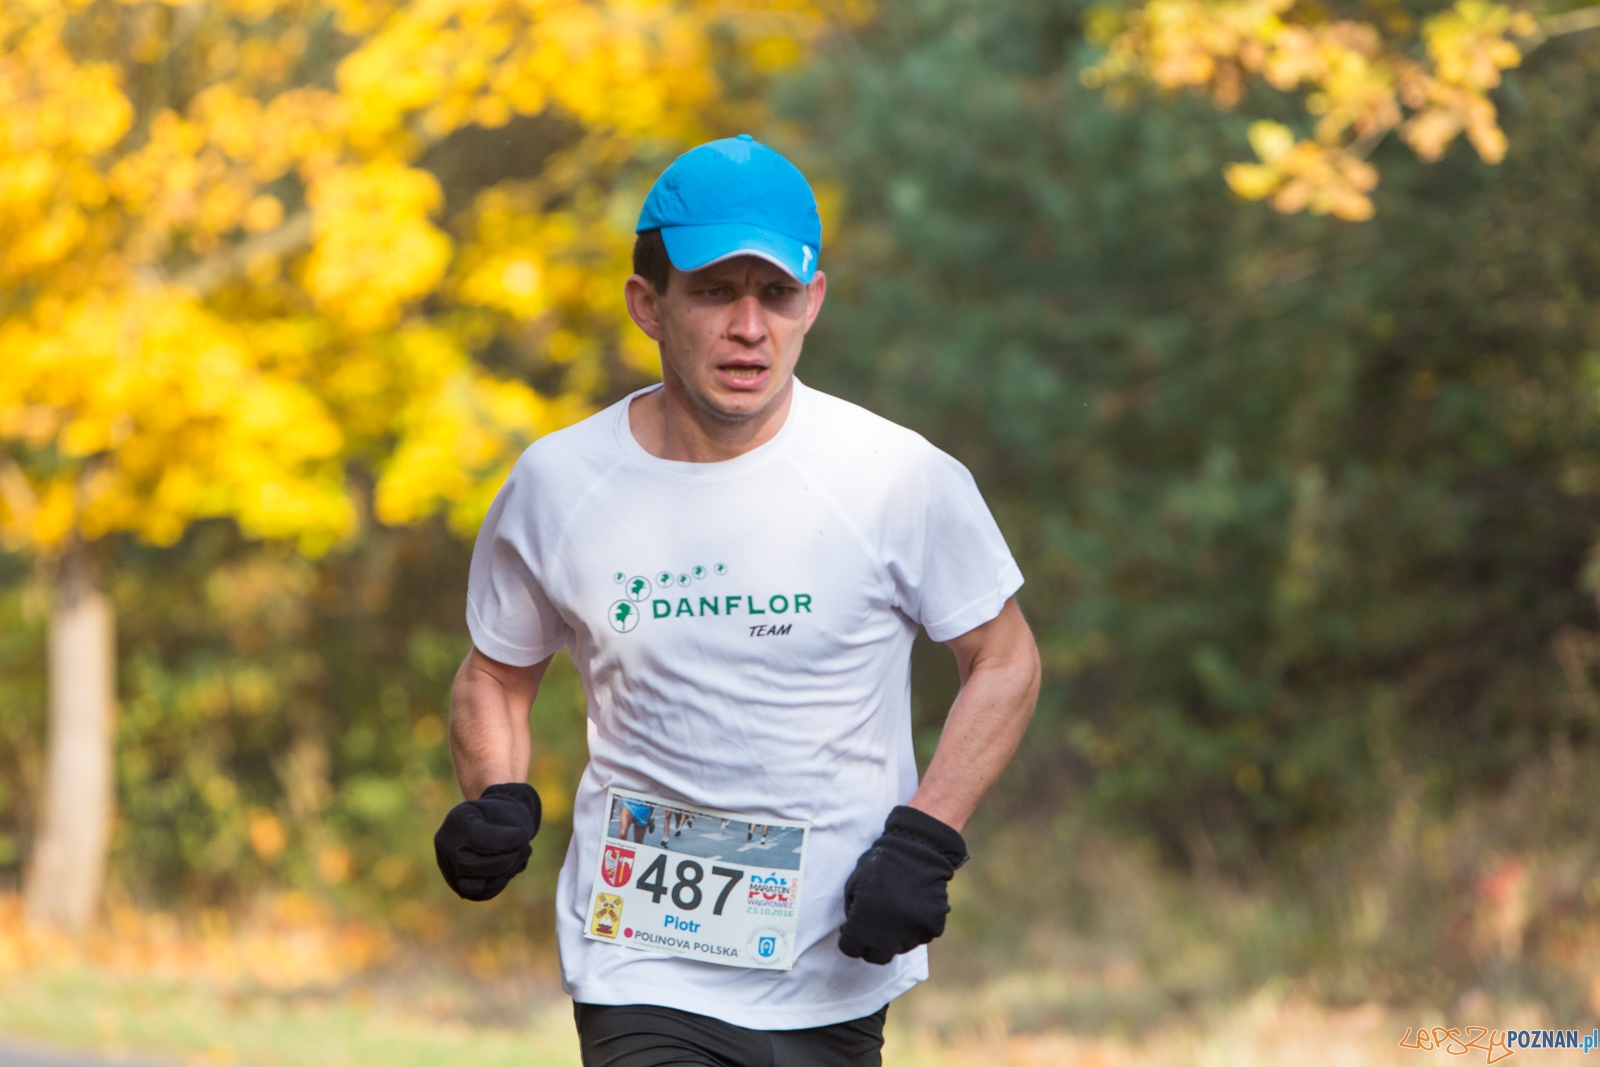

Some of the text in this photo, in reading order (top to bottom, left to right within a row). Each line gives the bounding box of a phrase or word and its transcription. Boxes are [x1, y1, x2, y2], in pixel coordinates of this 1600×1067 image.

[653, 594, 813, 619] DANFLOR
[749, 624, 792, 638] TEAM
[635, 854, 745, 916] 487
[749, 883, 791, 895] MARATON
[746, 906, 794, 917] 23.10.2016
[664, 914, 701, 933] Piotr
[635, 930, 691, 950] POLINOVA
[693, 941, 739, 958] POLSKA
